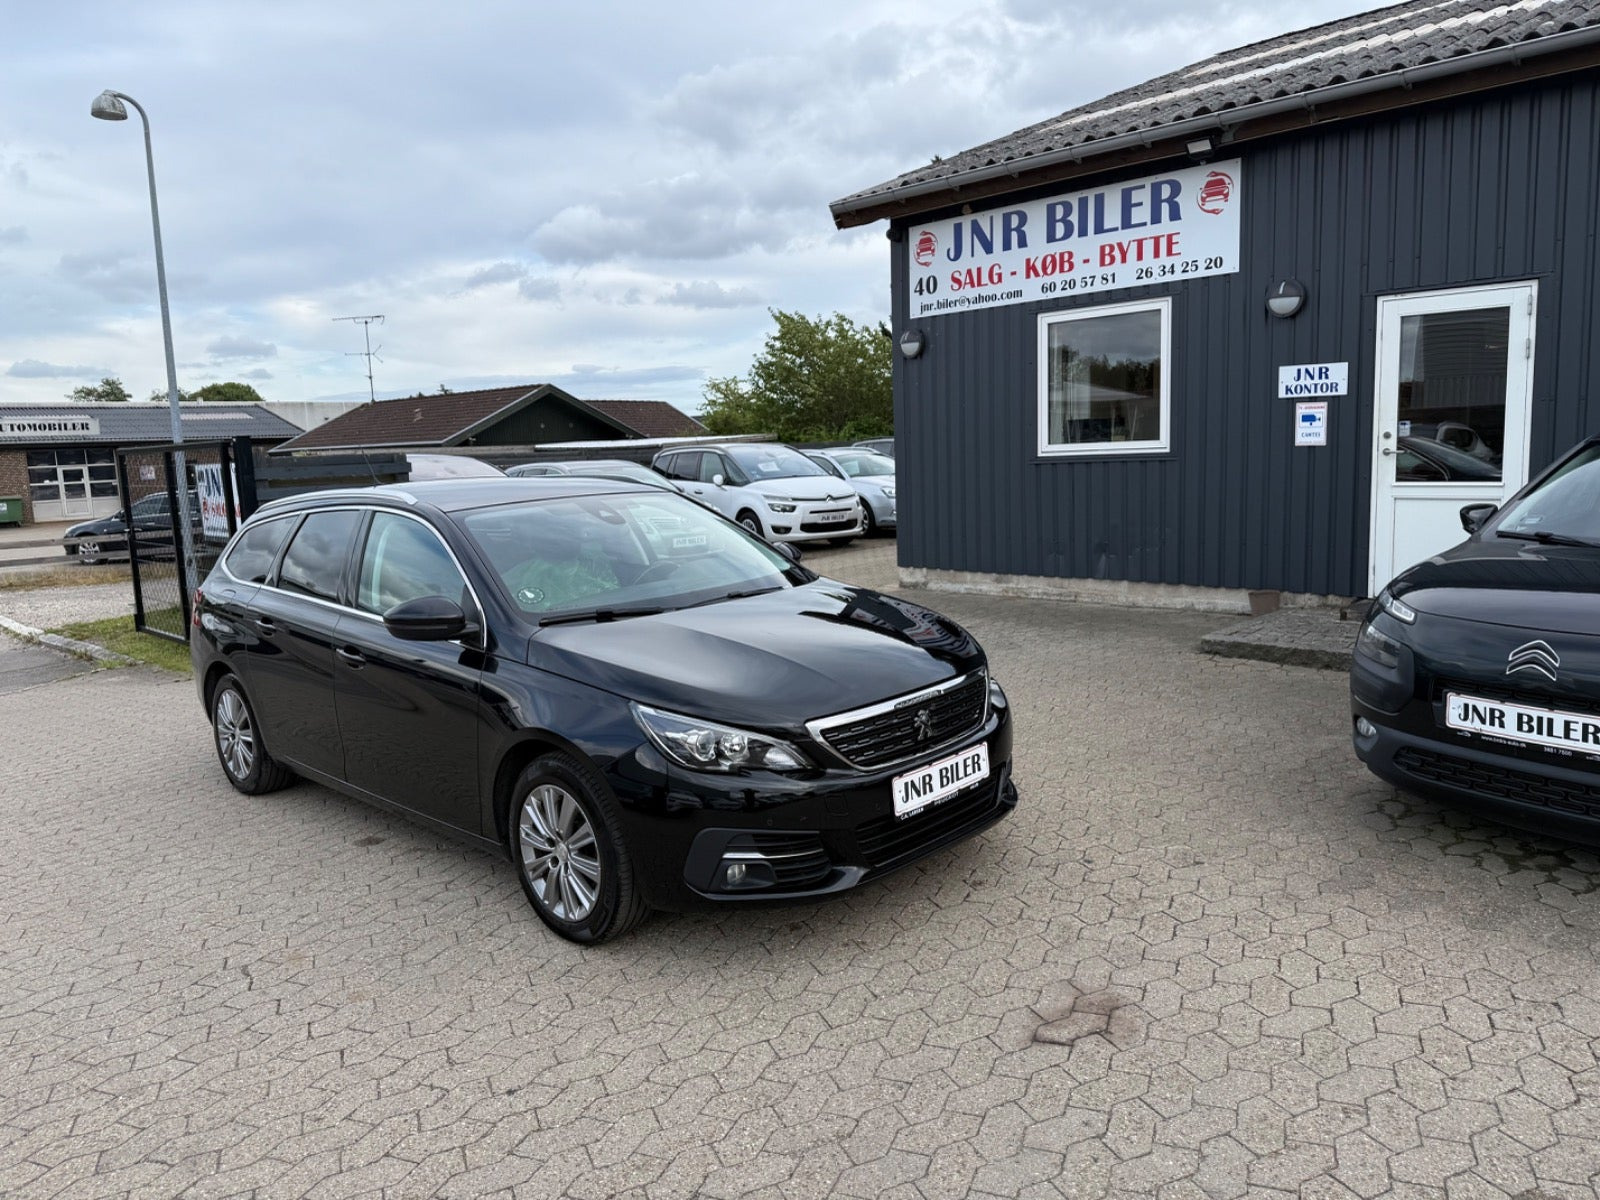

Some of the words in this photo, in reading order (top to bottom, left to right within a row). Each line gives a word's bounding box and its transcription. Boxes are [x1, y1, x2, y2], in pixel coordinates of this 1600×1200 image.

[947, 210, 1028, 262] JNR
[1046, 178, 1182, 243] BILER
[950, 263, 1002, 291] SALG
[1025, 250, 1074, 280] KØB
[1099, 232, 1181, 267] BYTTE
[1041, 281, 1056, 294] 60
[1060, 278, 1076, 291] 20
[1080, 276, 1096, 288] 57
[1100, 272, 1116, 285] 81
[1136, 267, 1153, 280] 26
[1158, 264, 1175, 277] 34
[1181, 261, 1198, 273] 25
[1204, 257, 1223, 270] 20
[914, 275, 938, 296] 40
[920, 288, 1023, 314] jnr.biler@yahoo.com
[1285, 382, 1338, 395] KONTOR
[1294, 366, 1329, 381] JNR
[1458, 703, 1505, 729] JNR
[1516, 712, 1600, 746] BILER
[902, 773, 932, 803] JNR
[939, 753, 981, 788] BILER
